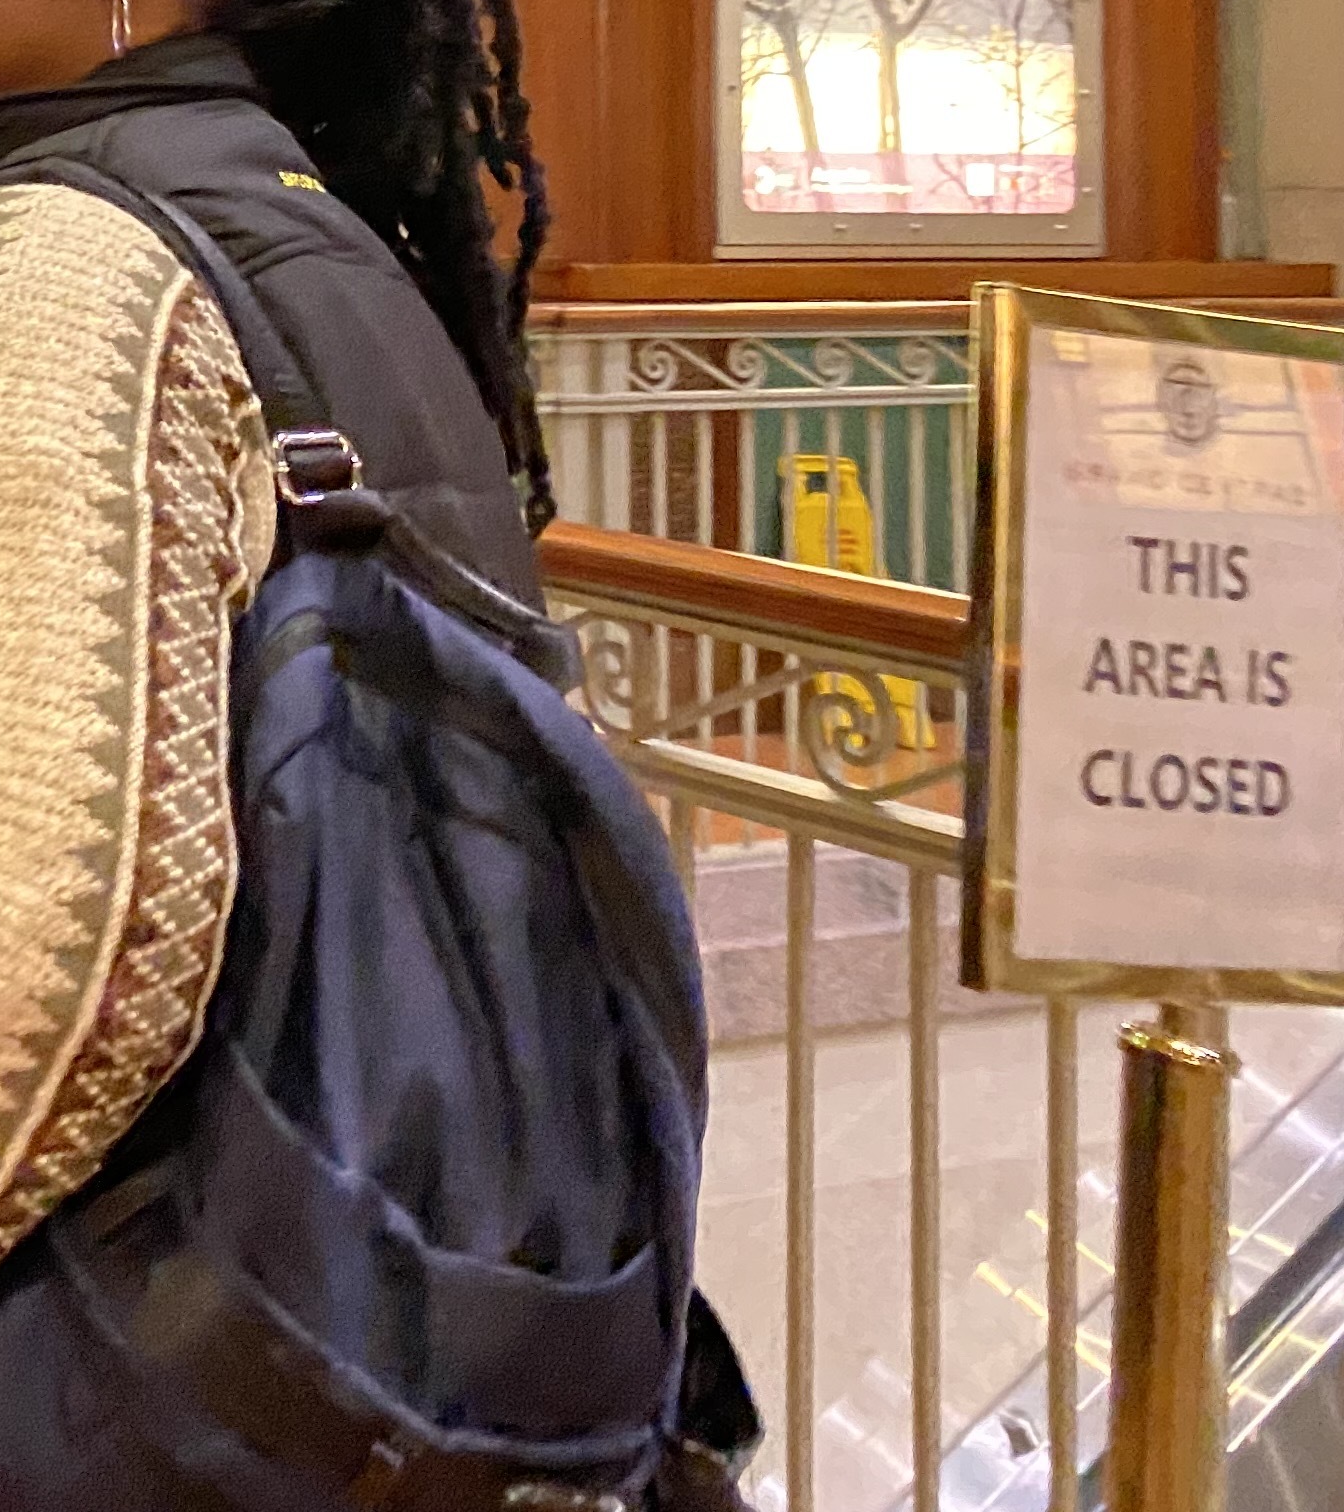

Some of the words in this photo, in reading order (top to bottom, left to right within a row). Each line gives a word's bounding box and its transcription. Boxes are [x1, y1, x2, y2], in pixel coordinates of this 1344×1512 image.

[1125, 535, 1250, 601] THIS
[1082, 637, 1227, 704] AREA
[1246, 649, 1292, 707] IS
[1080, 749, 1292, 816] CLOSED
